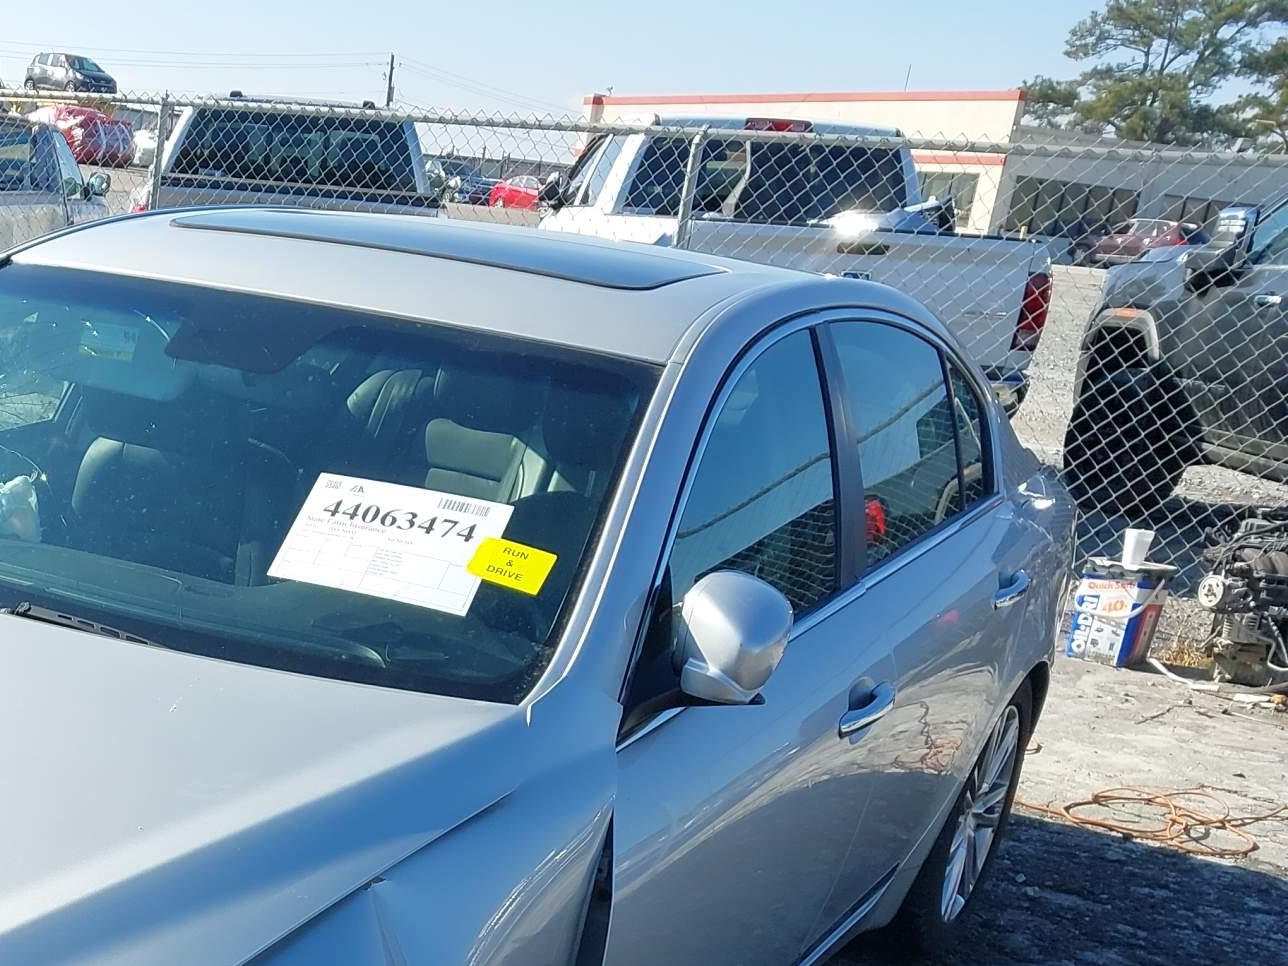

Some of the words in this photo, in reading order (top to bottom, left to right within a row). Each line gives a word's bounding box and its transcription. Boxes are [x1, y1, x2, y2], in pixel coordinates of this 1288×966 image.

[323, 498, 478, 543] 44063474
[502, 547, 530, 561] RUN
[506, 559, 515, 568] &
[486, 564, 525, 582] DRIVE
